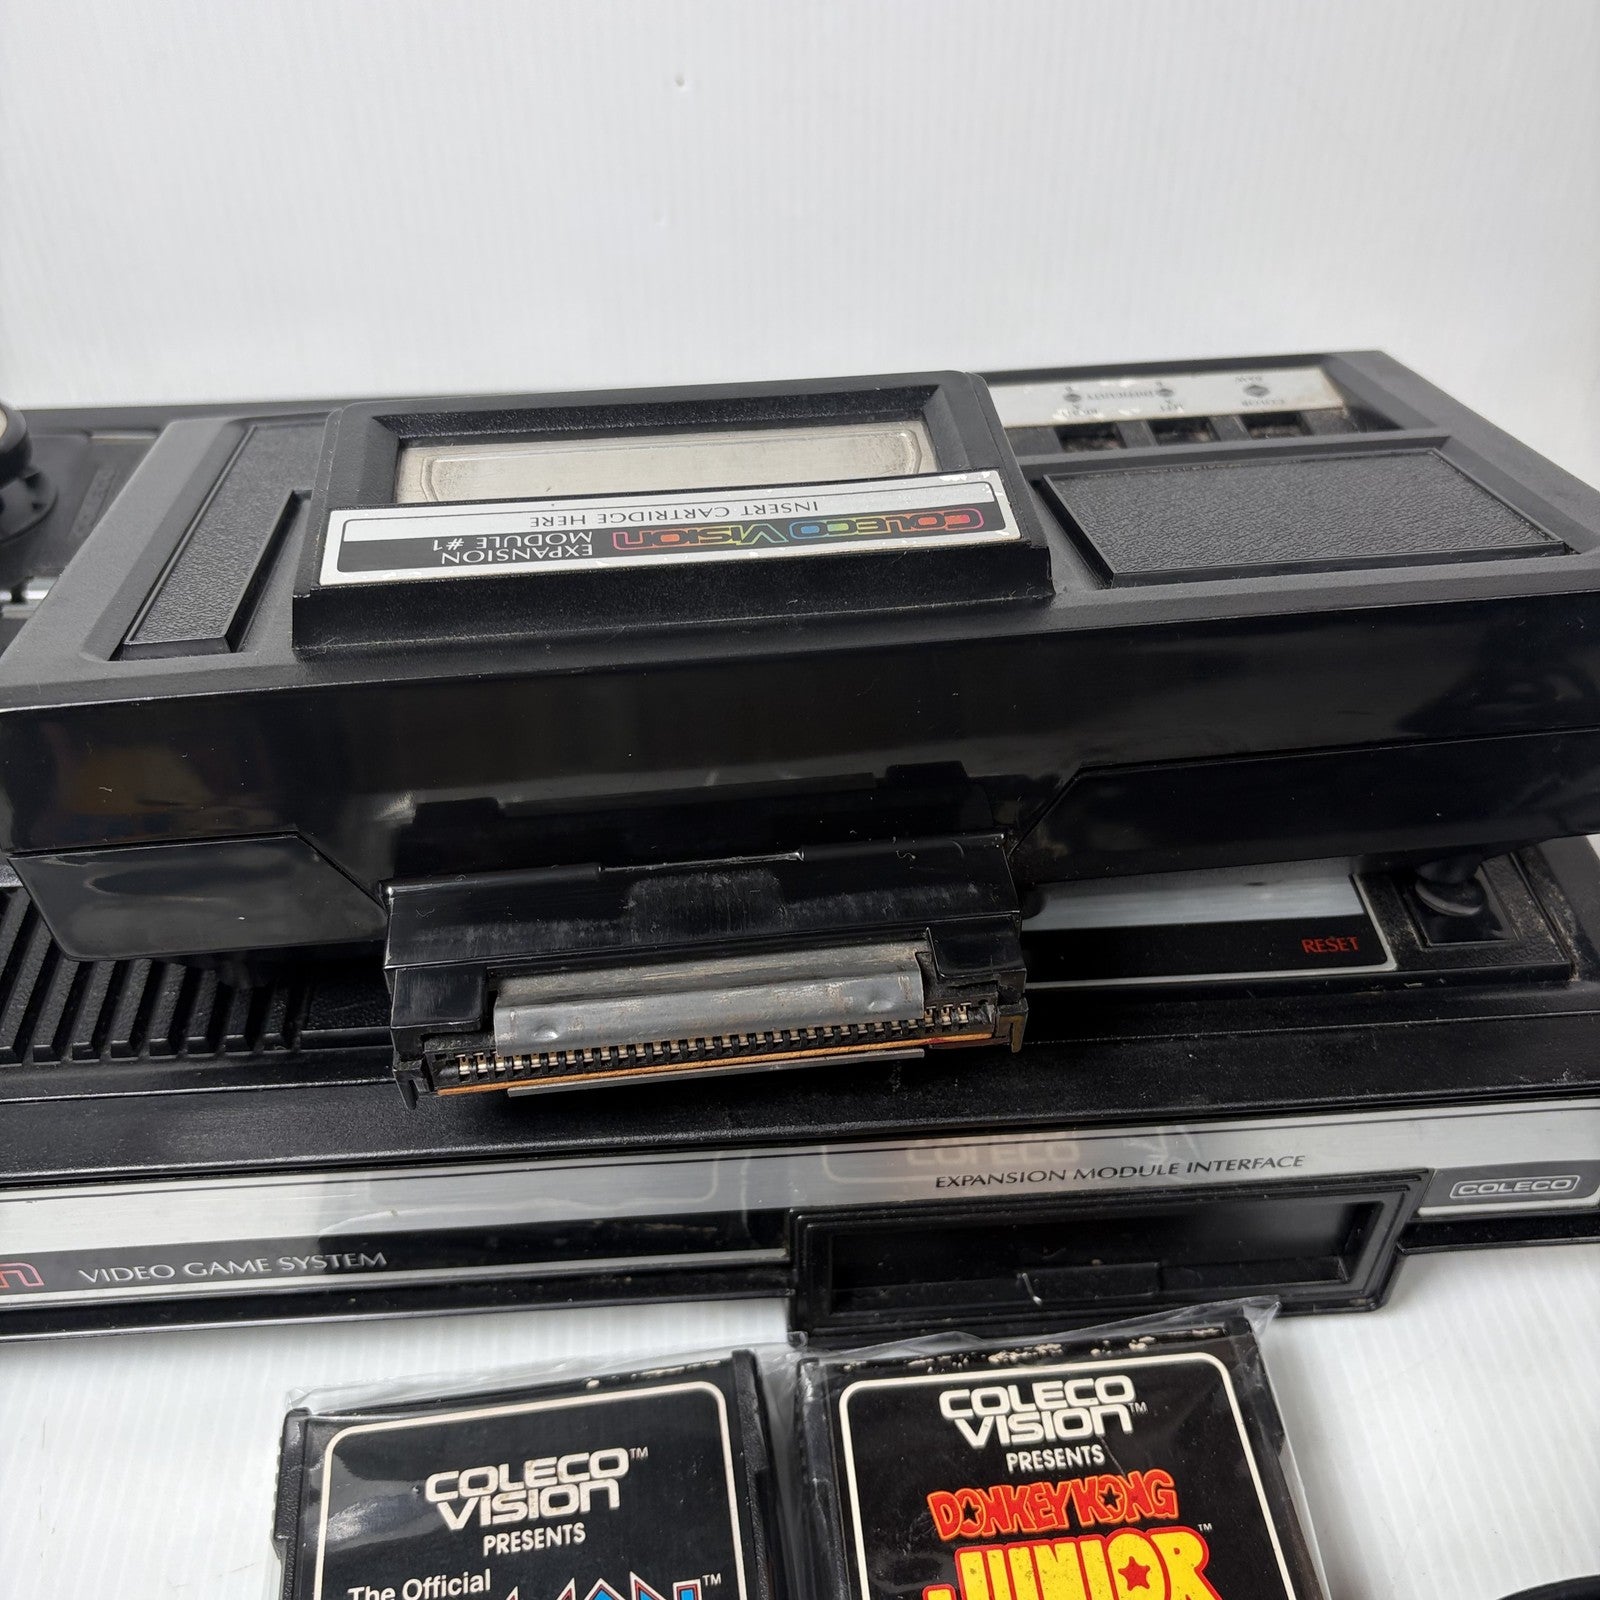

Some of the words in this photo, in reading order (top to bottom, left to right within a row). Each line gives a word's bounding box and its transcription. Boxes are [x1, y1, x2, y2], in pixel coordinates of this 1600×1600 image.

[530, 515, 586, 529] HERE
[598, 506, 730, 524] CARTRIDGE
[741, 501, 819, 516] INSERT
[432, 538, 465, 552] #1
[441, 543, 593, 565] EXPANSION
[476, 531, 593, 550] MODULE
[1301, 936, 1360, 954] RESET
[935, 1169, 1067, 1190] EXPANSION
[1074, 1162, 1179, 1182] MODULE
[1187, 1154, 1306, 1175] INTERFACE
[1458, 1179, 1572, 1196] COLECO
[79, 1264, 176, 1284] VIDEO
[183, 1257, 273, 1278] GAME
[278, 1251, 388, 1272] SYSTEM
[938, 1374, 1137, 1421] COLECO
[424, 1447, 630, 1502] COLECO
[1005, 1444, 1105, 1474] PRESENTS
[436, 1479, 621, 1532] VISION
[927, 1481, 1071, 1542] DONKEY
[1069, 1468, 1180, 1531] KONG
[483, 1522, 586, 1556] PRESENTS
[922, 1526, 1222, 1600] JUNIOR
[347, 1585, 397, 1600] The
[401, 1568, 492, 1600] Official
